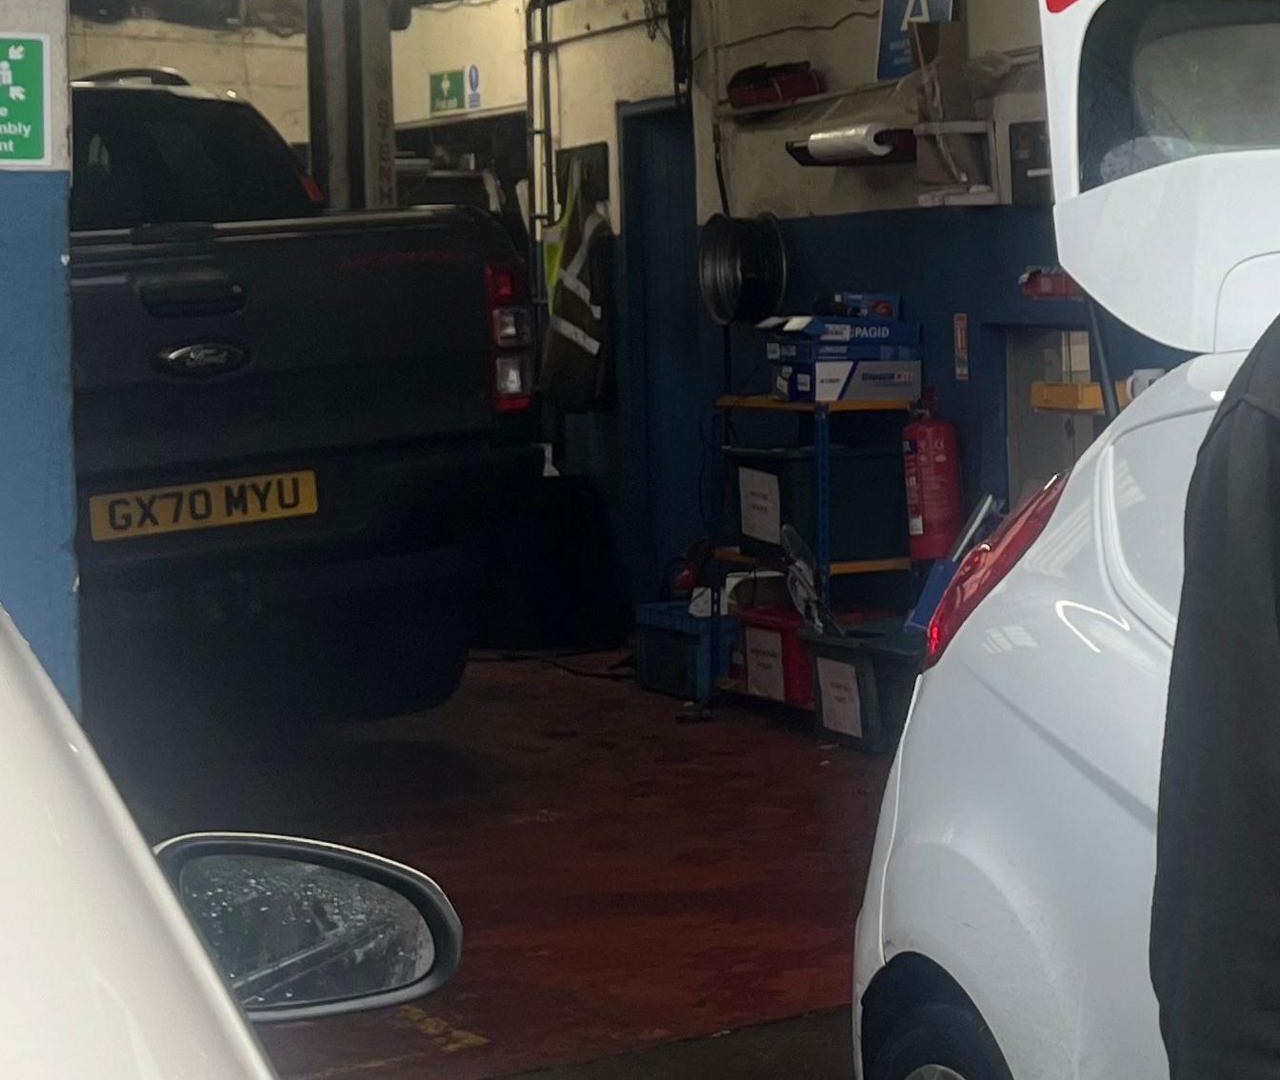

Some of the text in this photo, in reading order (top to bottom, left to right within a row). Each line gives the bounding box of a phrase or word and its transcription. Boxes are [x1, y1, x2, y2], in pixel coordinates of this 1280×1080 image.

[855, 326, 890, 338] PAGID
[107, 476, 300, 532] GX70 MYU
